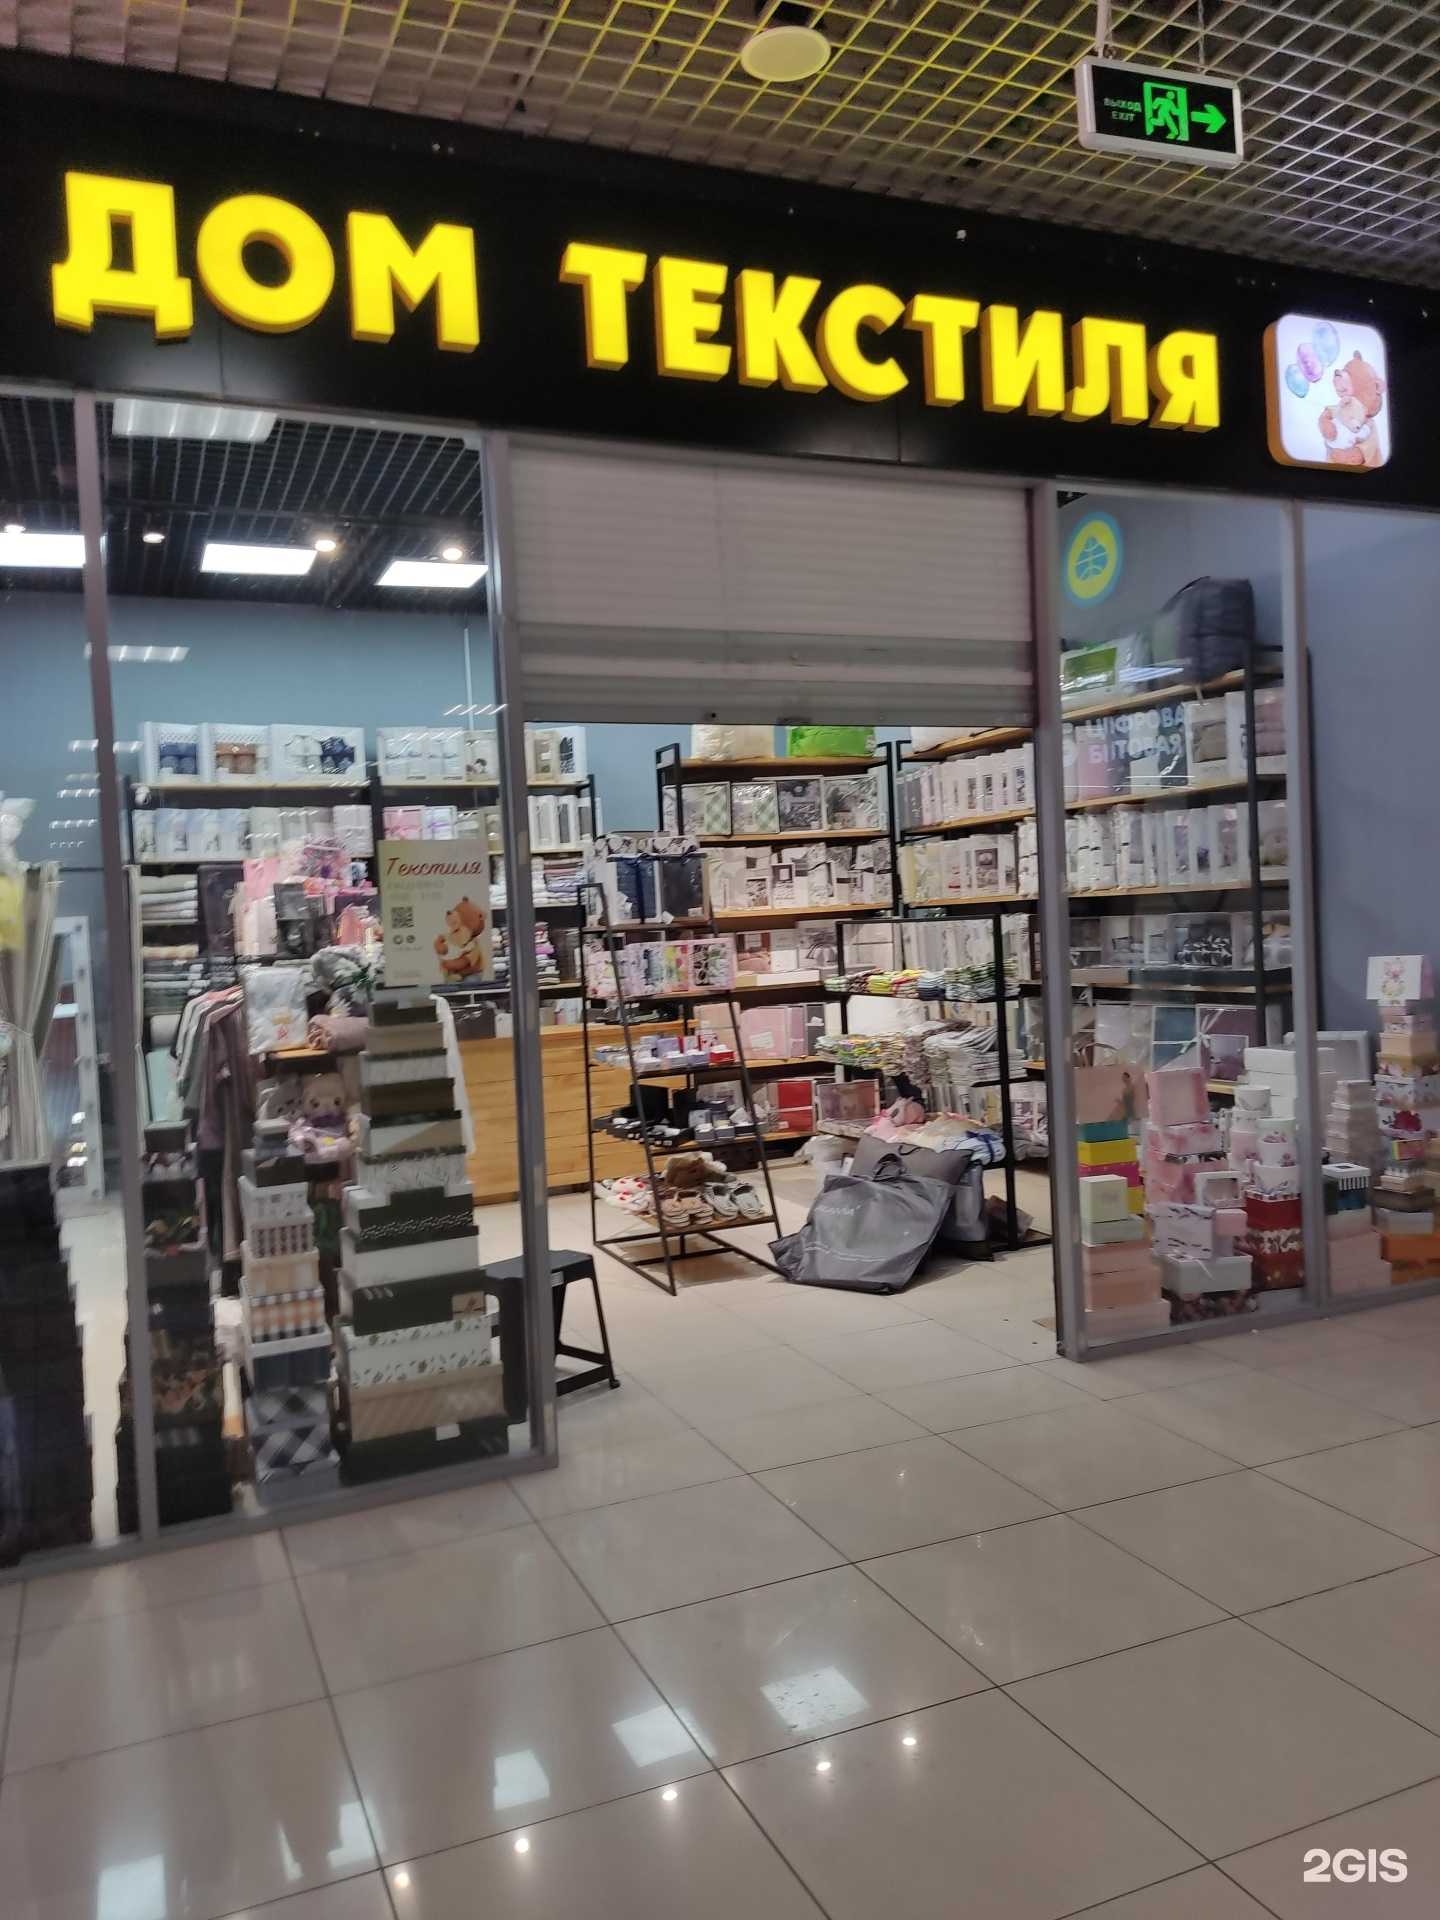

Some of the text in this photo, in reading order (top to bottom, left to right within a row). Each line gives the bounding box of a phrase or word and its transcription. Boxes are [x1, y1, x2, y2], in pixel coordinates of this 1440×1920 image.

[1103, 97, 1142, 113] ВЫХОД
[1111, 110, 1136, 122] EXIT
[51, 171, 1222, 433] ДОМ ТЕКСТИЛЯ
[385, 857, 482, 877] Текстиля
